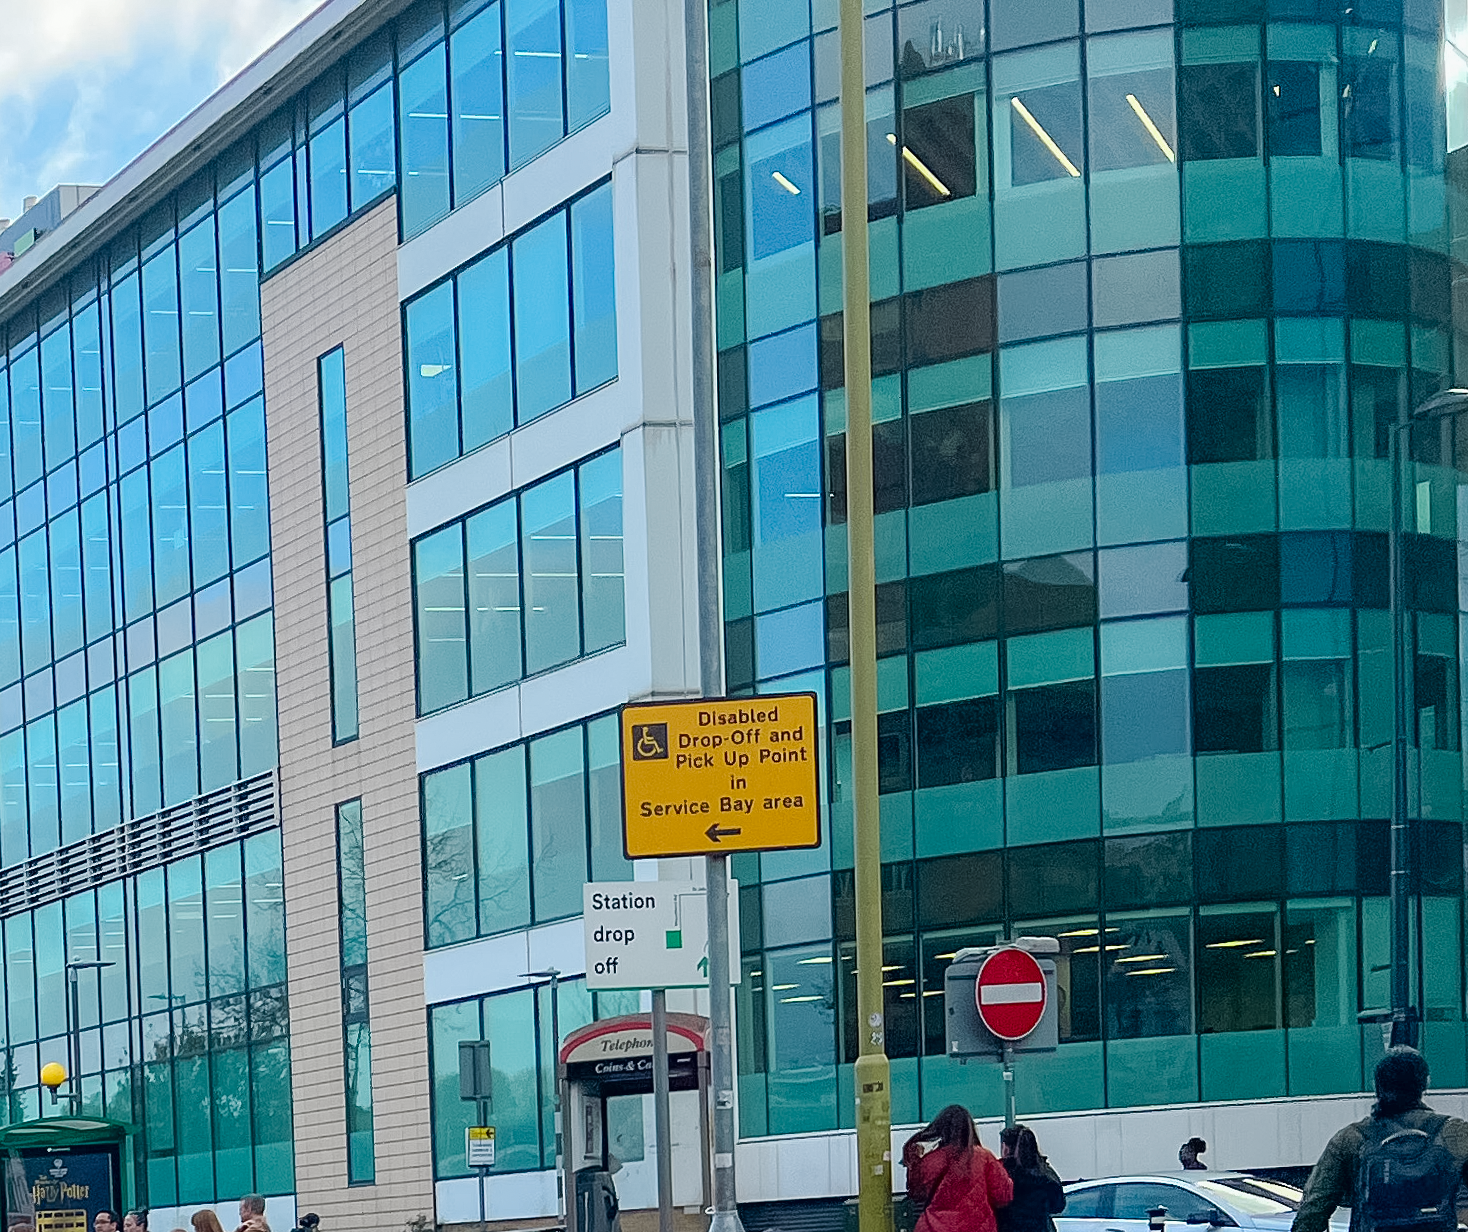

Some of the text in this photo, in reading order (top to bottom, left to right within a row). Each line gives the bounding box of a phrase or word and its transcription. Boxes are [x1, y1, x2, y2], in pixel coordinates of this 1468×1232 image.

[698, 706, 779, 727] Disabled
[678, 726, 804, 749] Drop-Off and
[676, 747, 808, 769] Pick Up Point
[730, 775, 747, 790] in
[639, 794, 804, 818] Service Bay area
[591, 892, 656, 911] Station
[593, 925, 635, 945] drop
[594, 957, 619, 975] off
[601, 1037, 654, 1052] Telephon
[595, 1062, 624, 1074] Coins
[625, 1061, 635, 1071] &
[60, 1181, 89, 1204] Potter
